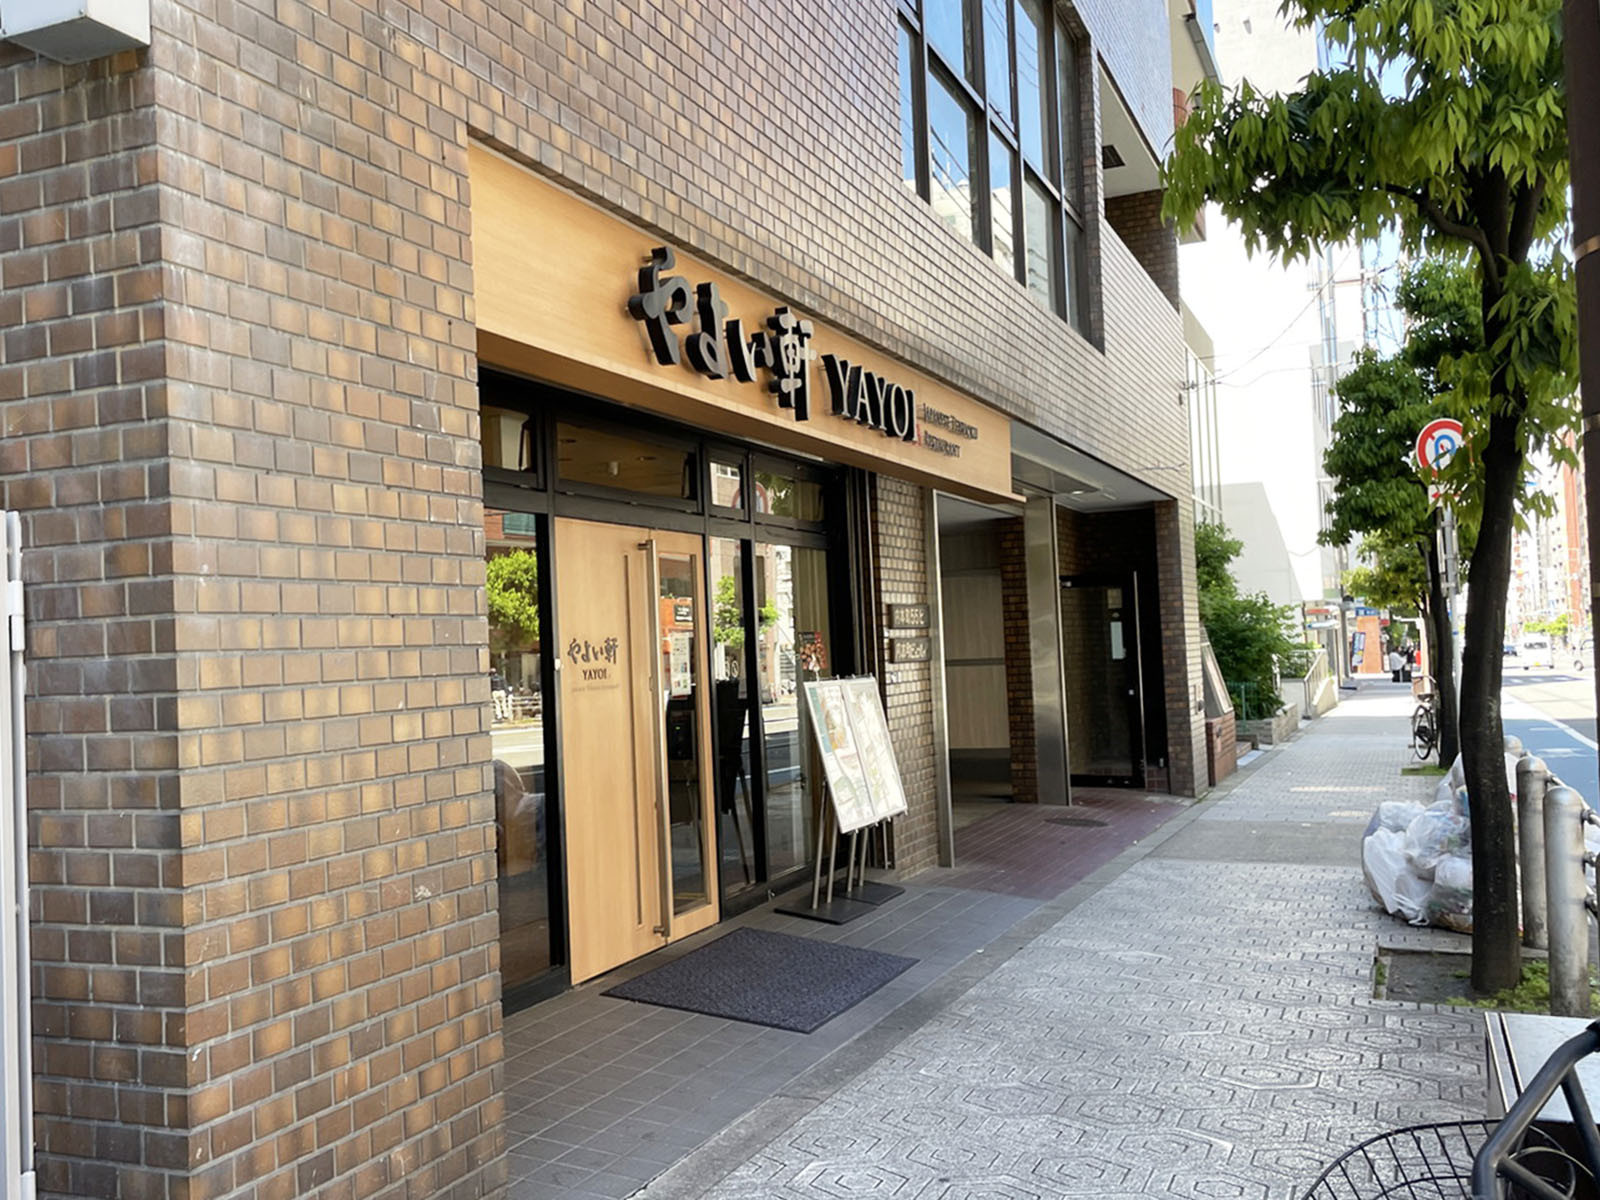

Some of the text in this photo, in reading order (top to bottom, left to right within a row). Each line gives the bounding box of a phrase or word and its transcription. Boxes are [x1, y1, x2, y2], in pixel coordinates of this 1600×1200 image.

[628, 246, 917, 442] やよい軒 YAYOI
[567, 637, 619, 665] やよい軒
[582, 668, 607, 681] YAYOI
